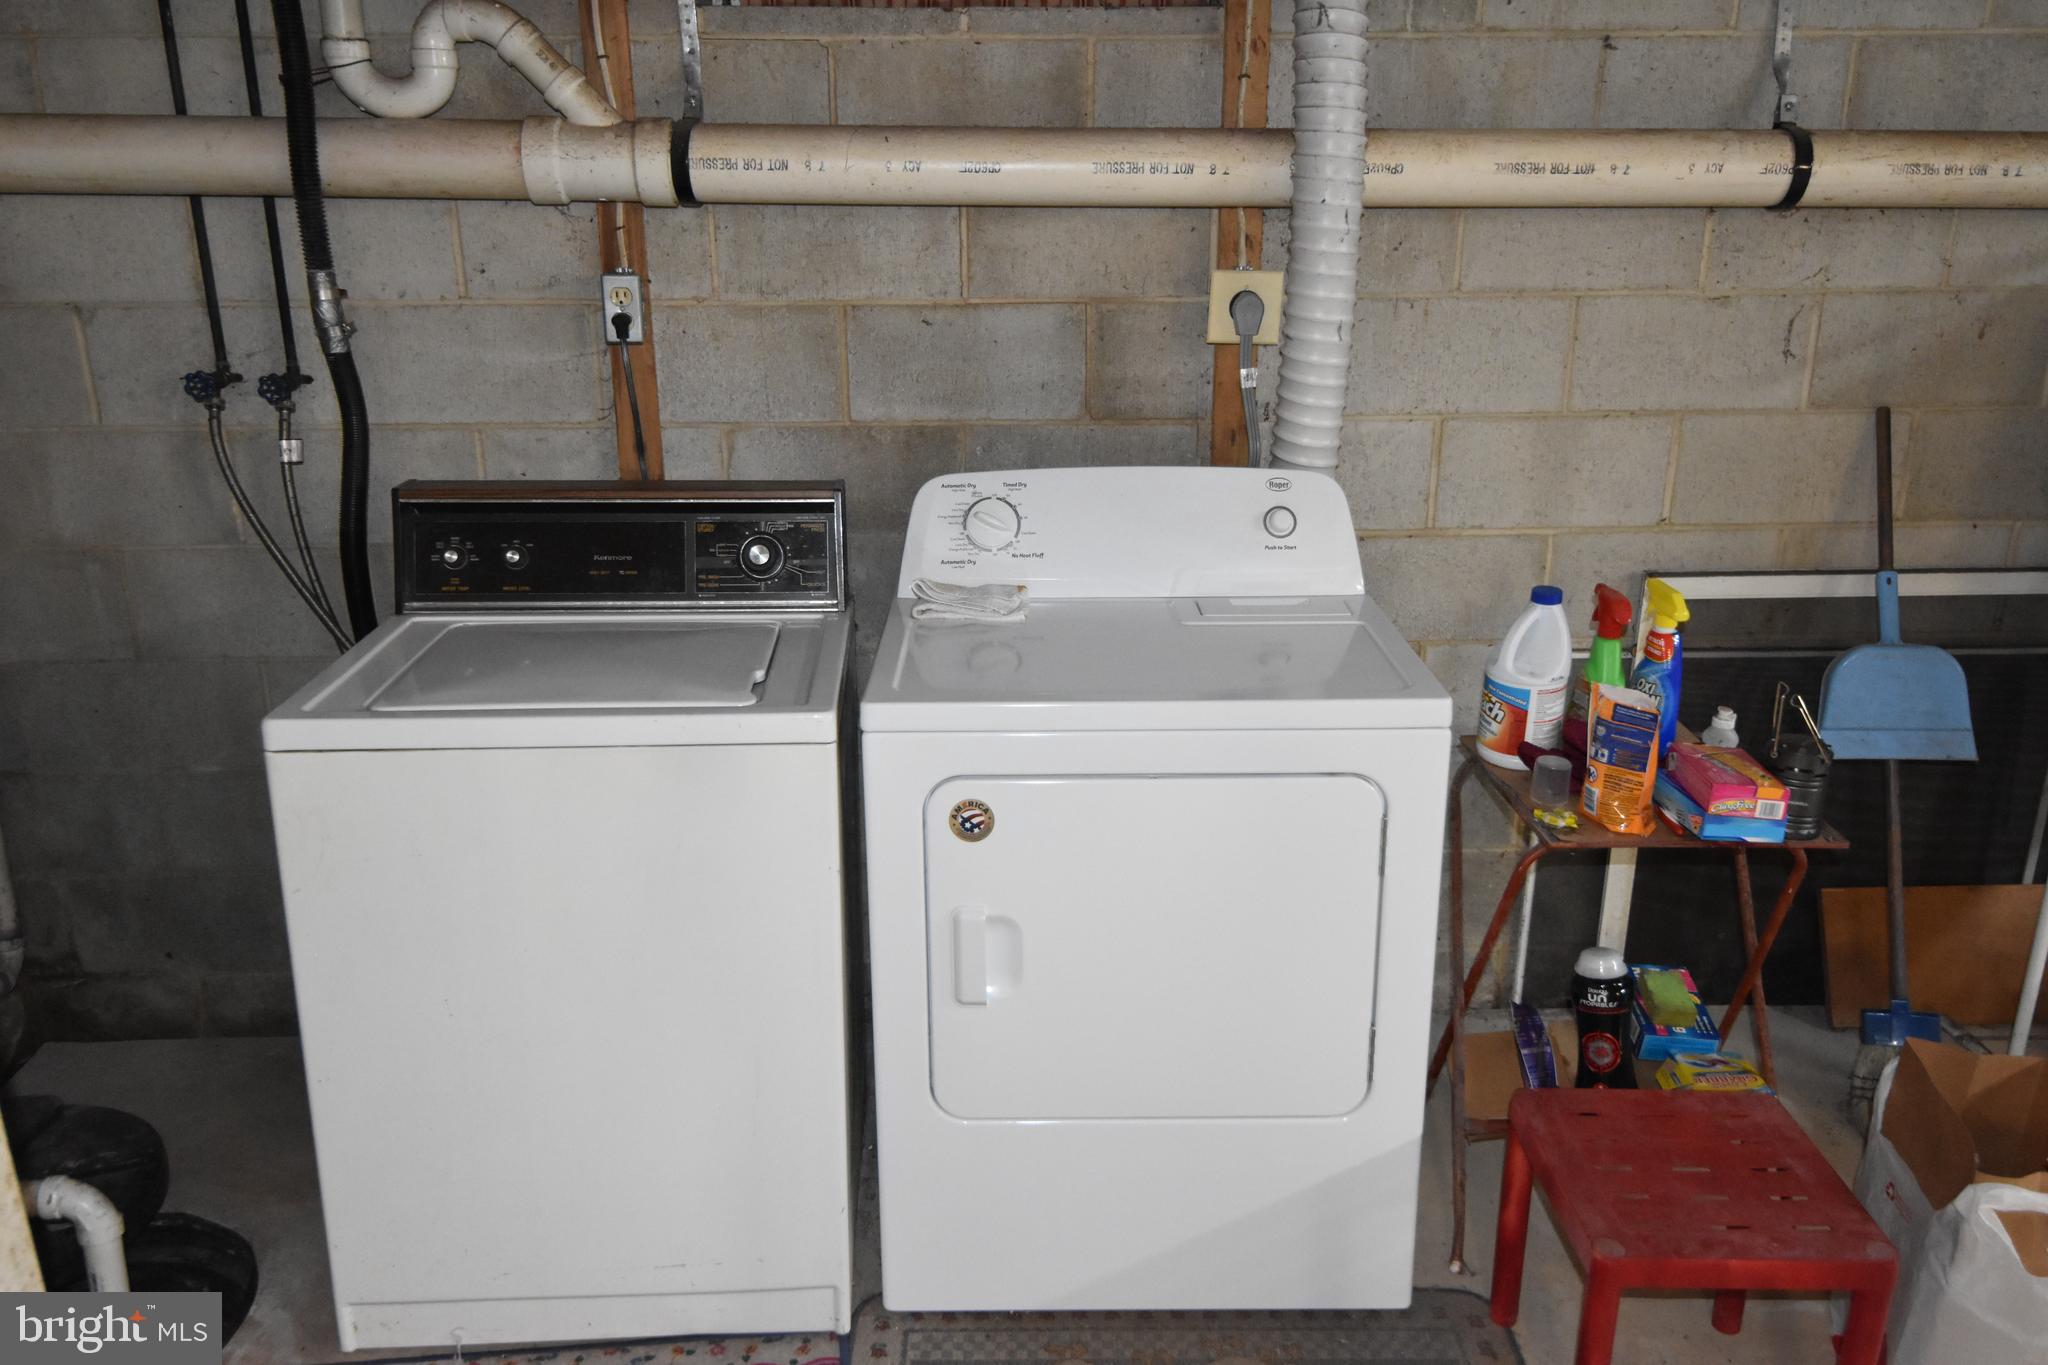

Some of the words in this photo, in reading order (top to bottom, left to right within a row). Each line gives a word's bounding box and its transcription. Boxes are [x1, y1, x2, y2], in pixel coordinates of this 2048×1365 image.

[743, 158, 763, 171] FOR
[767, 159, 789, 171] NOT
[1092, 161, 1145, 174] PRESSURE
[1149, 162, 1169, 175] FOR
[1172, 163, 1195, 175] NOT
[1494, 162, 1546, 175] PRESSURE
[1550, 162, 1570, 175] FOR
[1573, 163, 1596, 175] NOT
[1888, 163, 1940, 176] PRESSURE
[1944, 164, 1963, 176] FOR
[1969, 165, 1989, 176] NOT
[1269, 480, 1289, 489] Roper
[1636, 678, 1656, 694] OXI
